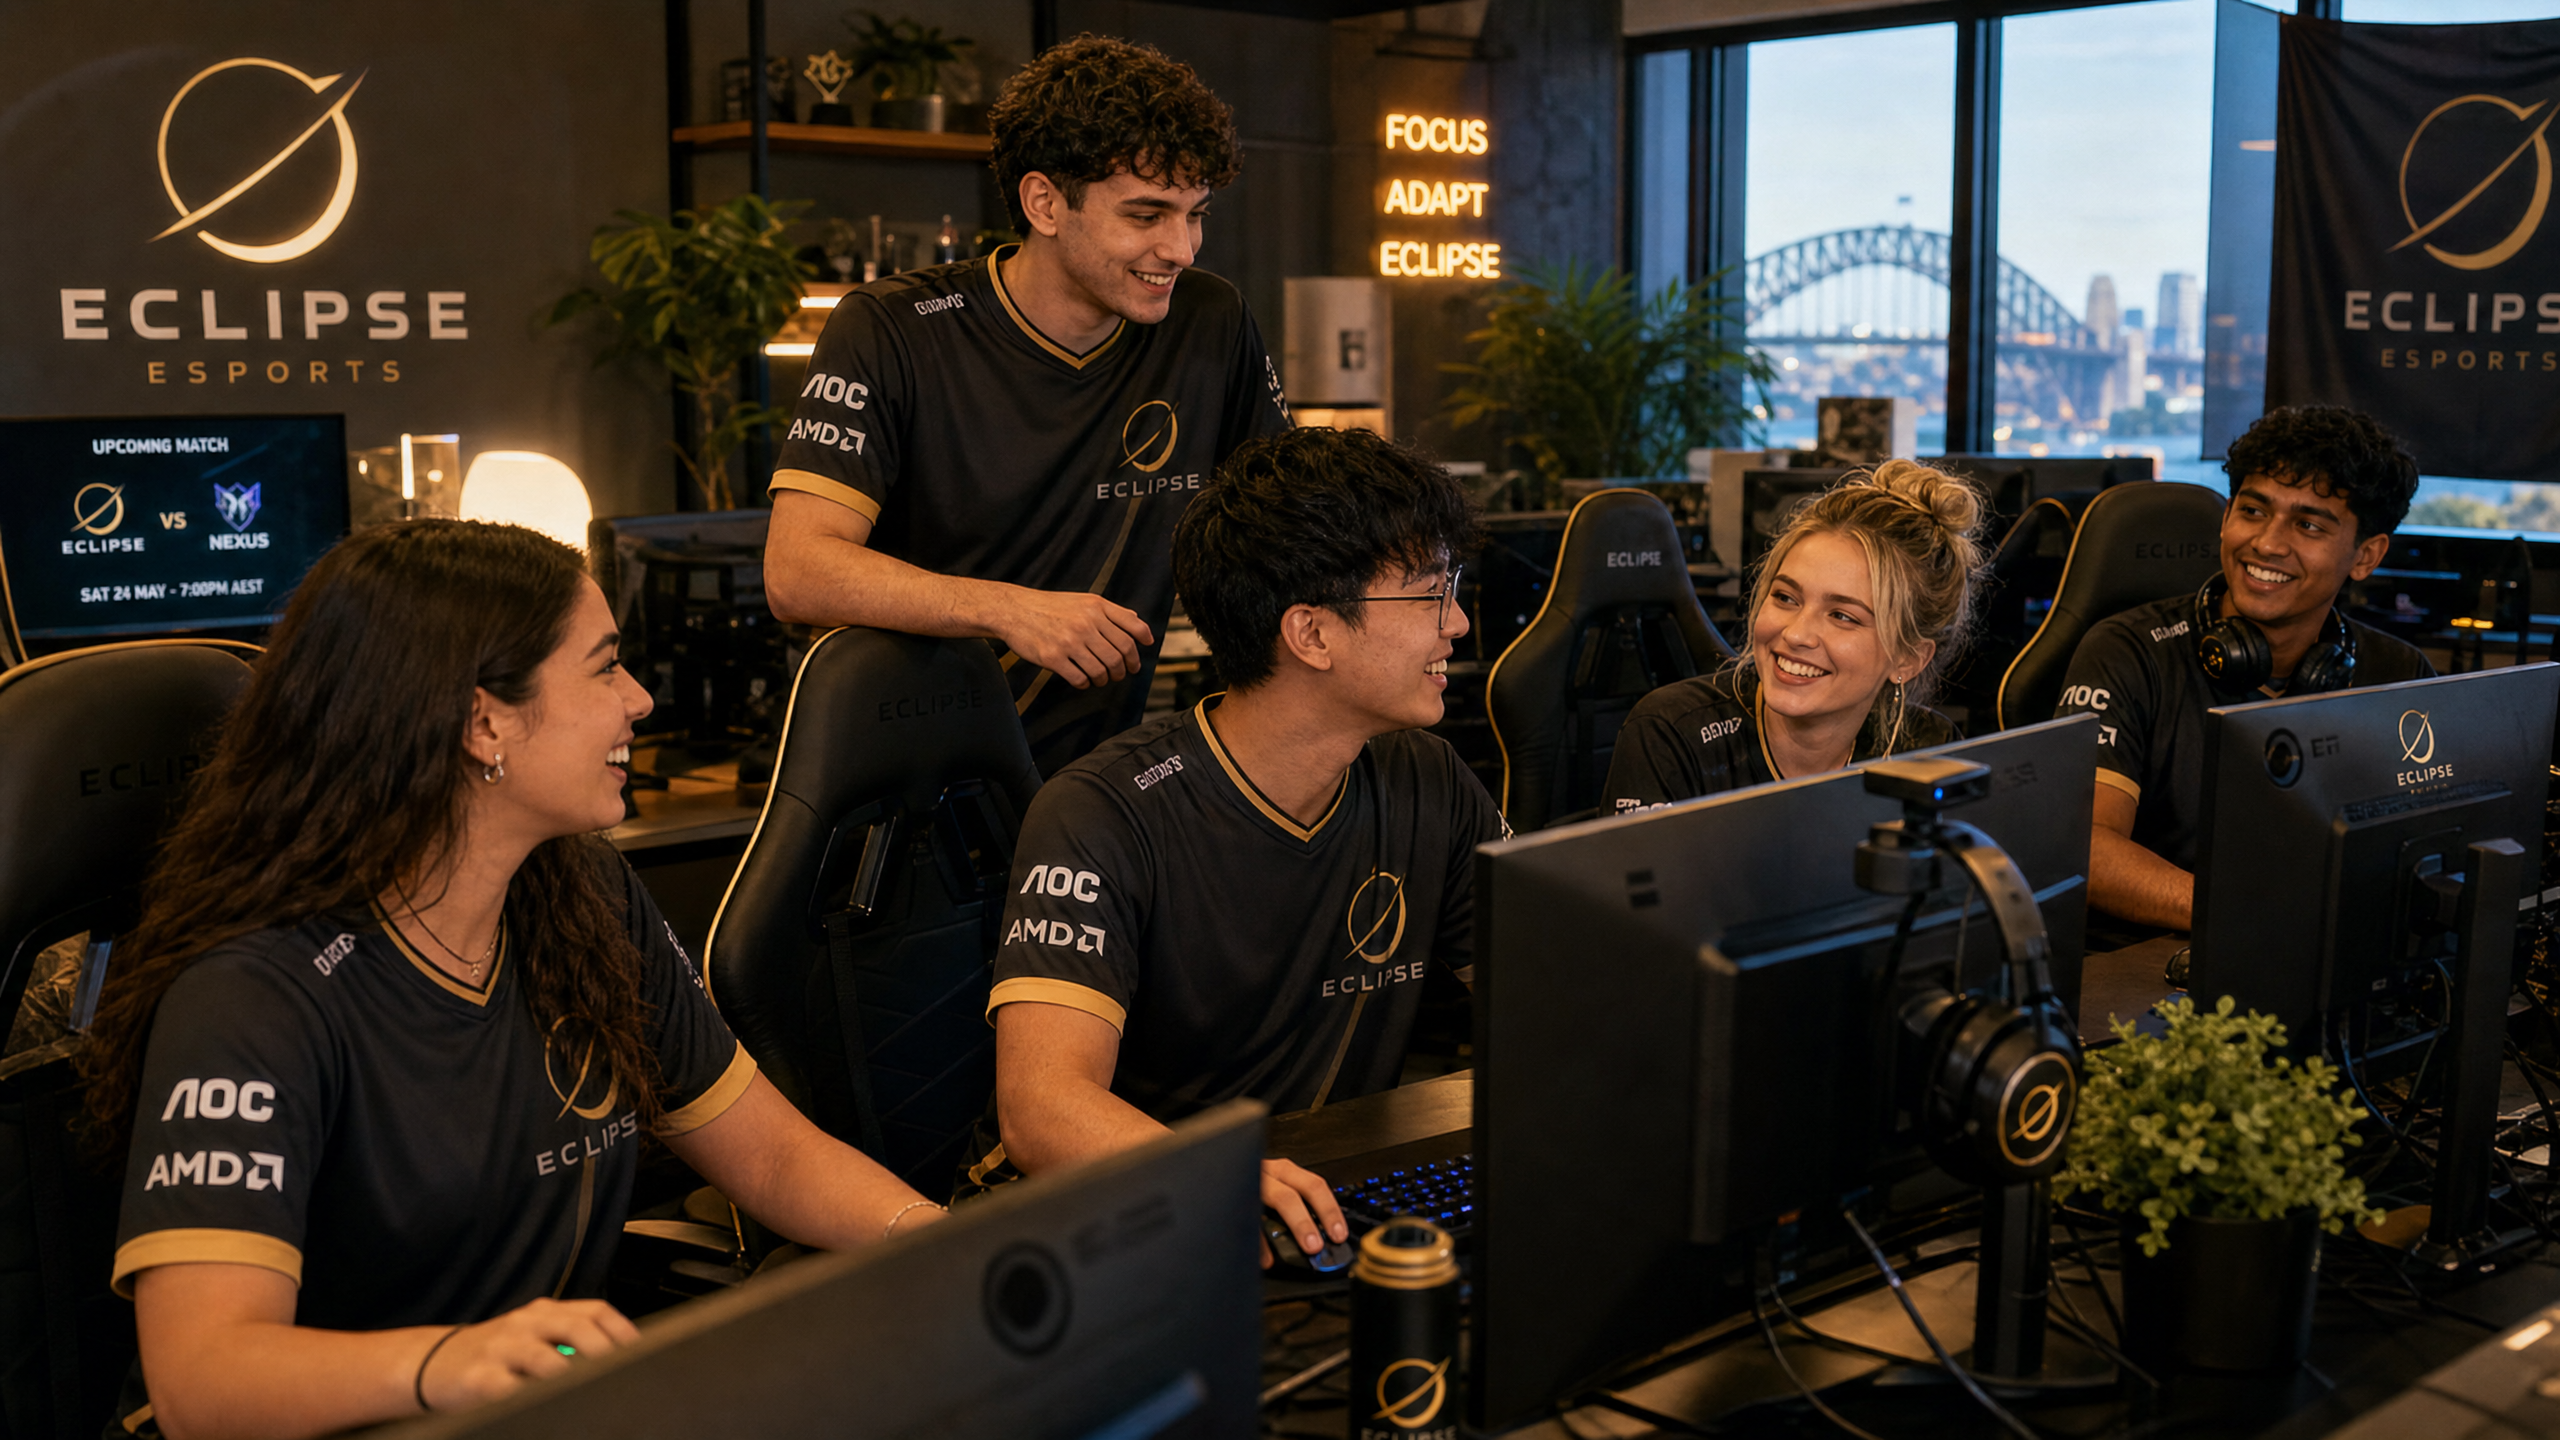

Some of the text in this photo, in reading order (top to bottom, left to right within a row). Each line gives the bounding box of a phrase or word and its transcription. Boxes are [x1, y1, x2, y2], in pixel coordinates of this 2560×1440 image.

[1385, 113, 1489, 155] FOCUS
[1384, 179, 1489, 217] ADAPT
[1380, 241, 1501, 279] ECLIPSE
[61, 289, 468, 340] ECLIPSE
[148, 361, 400, 384] ESPORTS
[2381, 349, 2557, 371] ESPORTS
[800, 373, 869, 411] AOC
[92, 437, 229, 455] UPCOMNG MATCH
[787, 418, 840, 446] AMD
[1096, 472, 1200, 500] ECLIPSE
[159, 512, 187, 530] VS
[62, 537, 145, 555] ECLIPSE
[209, 532, 270, 550] NEXUS
[2135, 543, 2220, 560] ECLIPS
[1606, 550, 1662, 568] ECLIPSE
[80, 586, 110, 603] SAT
[113, 585, 132, 601] 24
[134, 584, 167, 600] MAY
[180, 581, 229, 597] 7:00PM
[230, 578, 264, 595] AEST
[878, 690, 983, 722] ECLIPSE
[2058, 685, 2111, 711] AOC
[80, 755, 200, 797] ECLIP
[2396, 763, 2454, 787] ECLIPSE
[1019, 864, 1101, 904] AOC
[1004, 917, 1074, 946] AMD
[1322, 961, 1424, 998] ECLIPSE
[160, 1077, 276, 1123] AOC
[535, 1109, 638, 1177] ECLIPS
[143, 1150, 243, 1192] AMD
